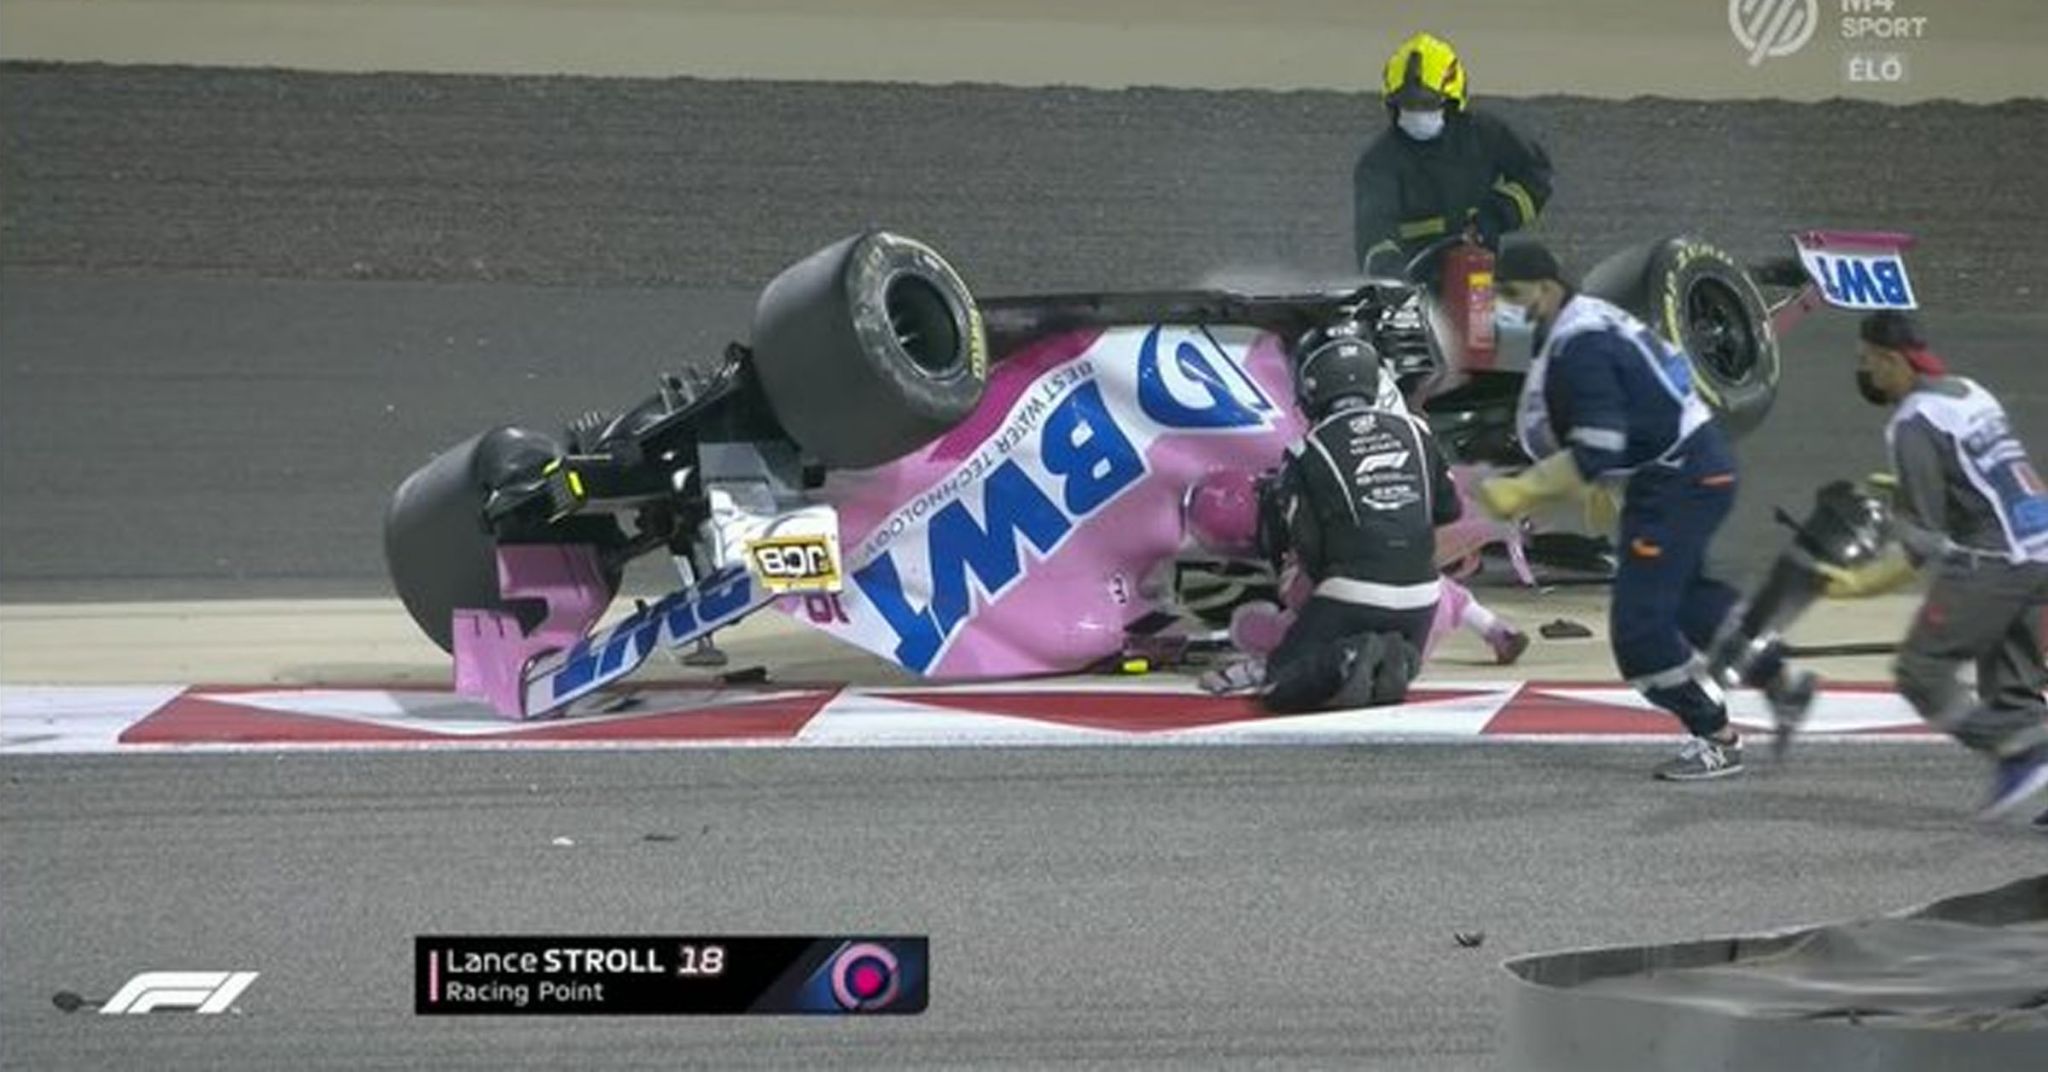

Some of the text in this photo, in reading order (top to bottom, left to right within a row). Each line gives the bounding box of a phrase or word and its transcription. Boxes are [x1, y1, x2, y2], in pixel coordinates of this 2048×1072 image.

[1815, 255, 1911, 305] BWT
[863, 359, 1095, 555] BEST WATER TECHNOLOGY
[760, 546, 822, 577] JCB
[852, 379, 1149, 676] BWT
